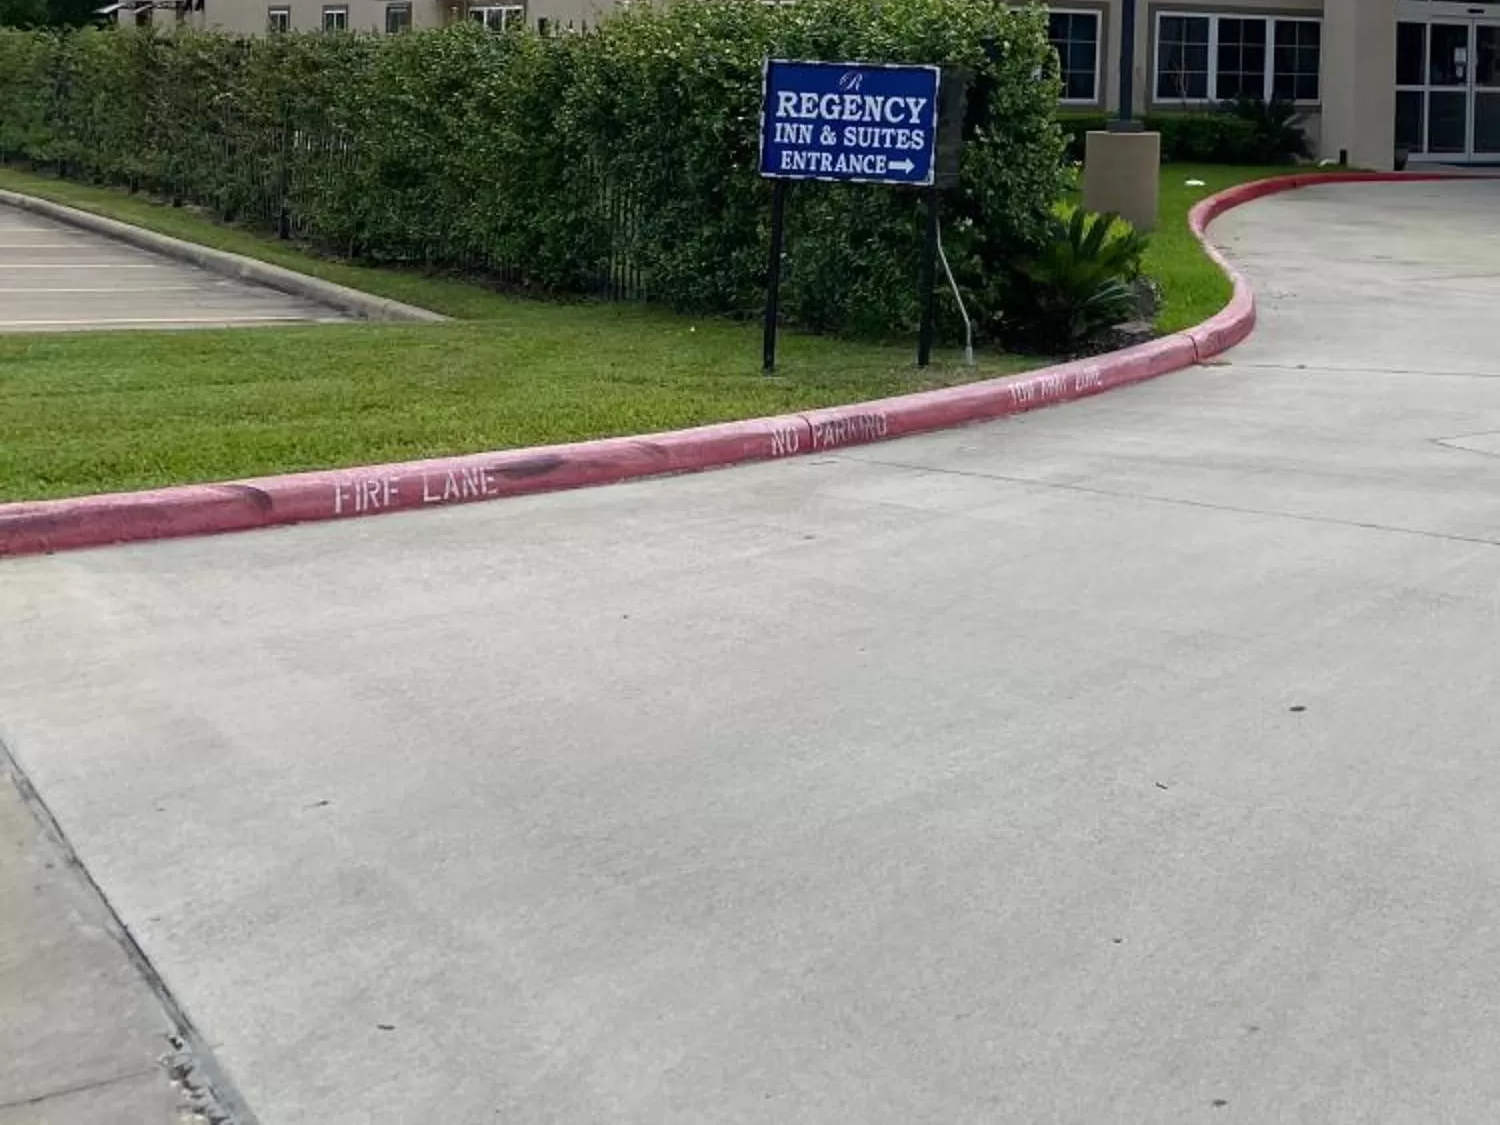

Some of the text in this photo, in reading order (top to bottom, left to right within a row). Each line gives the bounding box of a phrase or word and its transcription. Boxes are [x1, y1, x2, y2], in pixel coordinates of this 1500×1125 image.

[775, 90, 928, 124] REGENCY
[773, 122, 925, 150] INN & SUITES
[781, 150, 887, 175] ENTRANCE
[770, 425, 800, 456] NO
[423, 467, 499, 503] LANE
